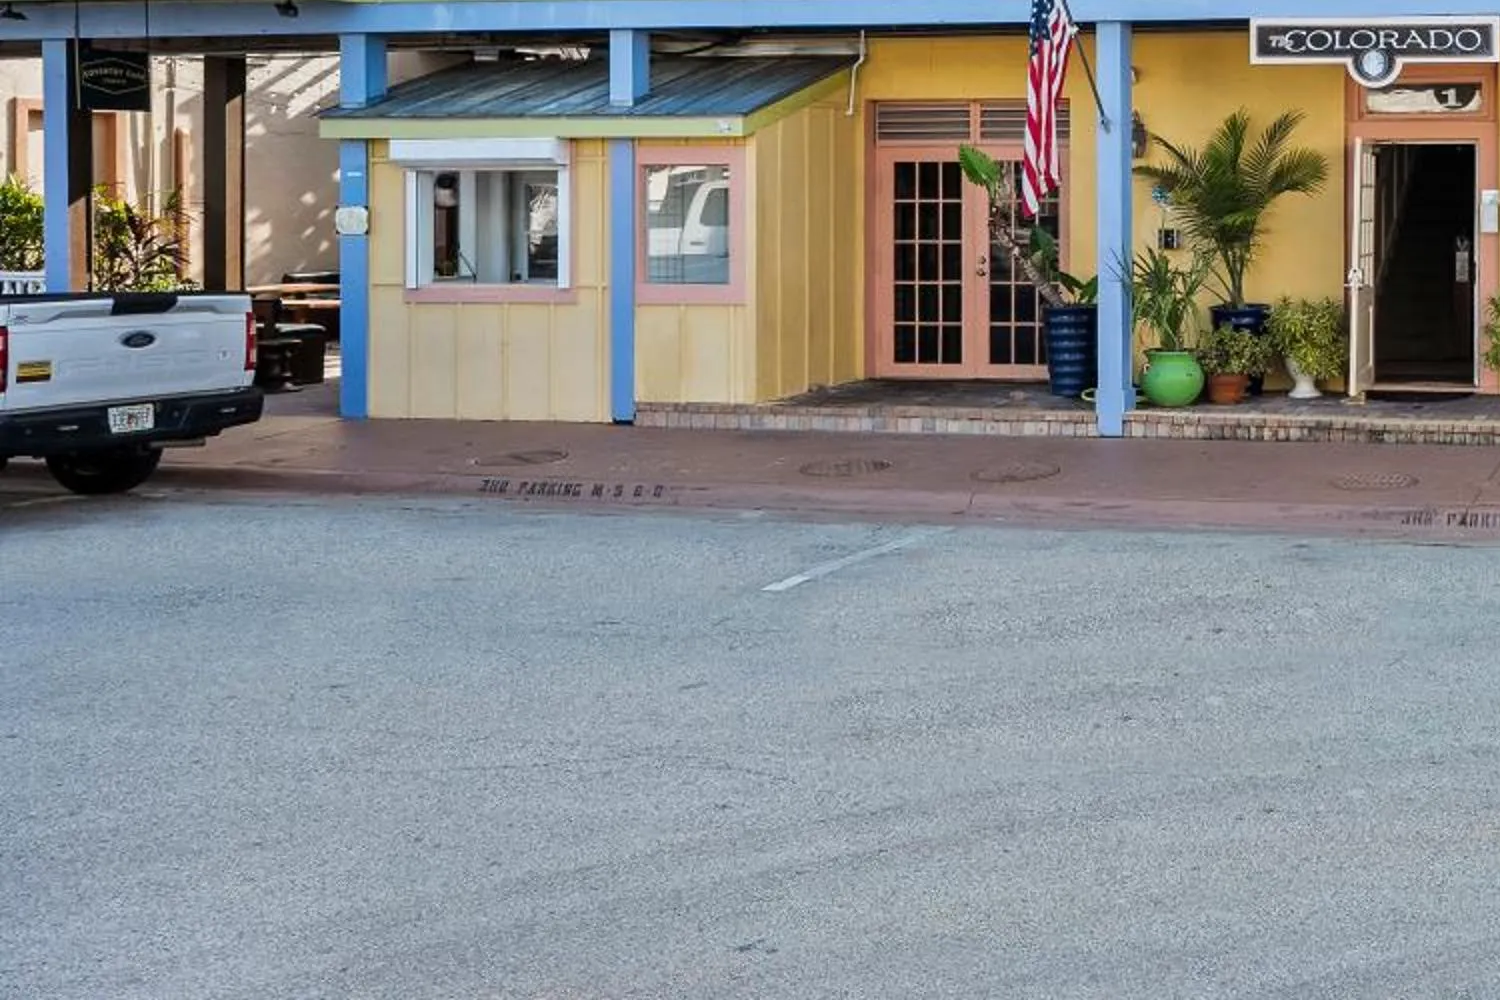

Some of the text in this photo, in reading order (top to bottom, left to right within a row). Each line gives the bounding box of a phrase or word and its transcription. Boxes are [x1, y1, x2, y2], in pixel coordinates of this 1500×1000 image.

[1285, 29, 1482, 52] COLORADO
[1442, 89, 1462, 107] 1
[517, 482, 583, 497] PARKING
